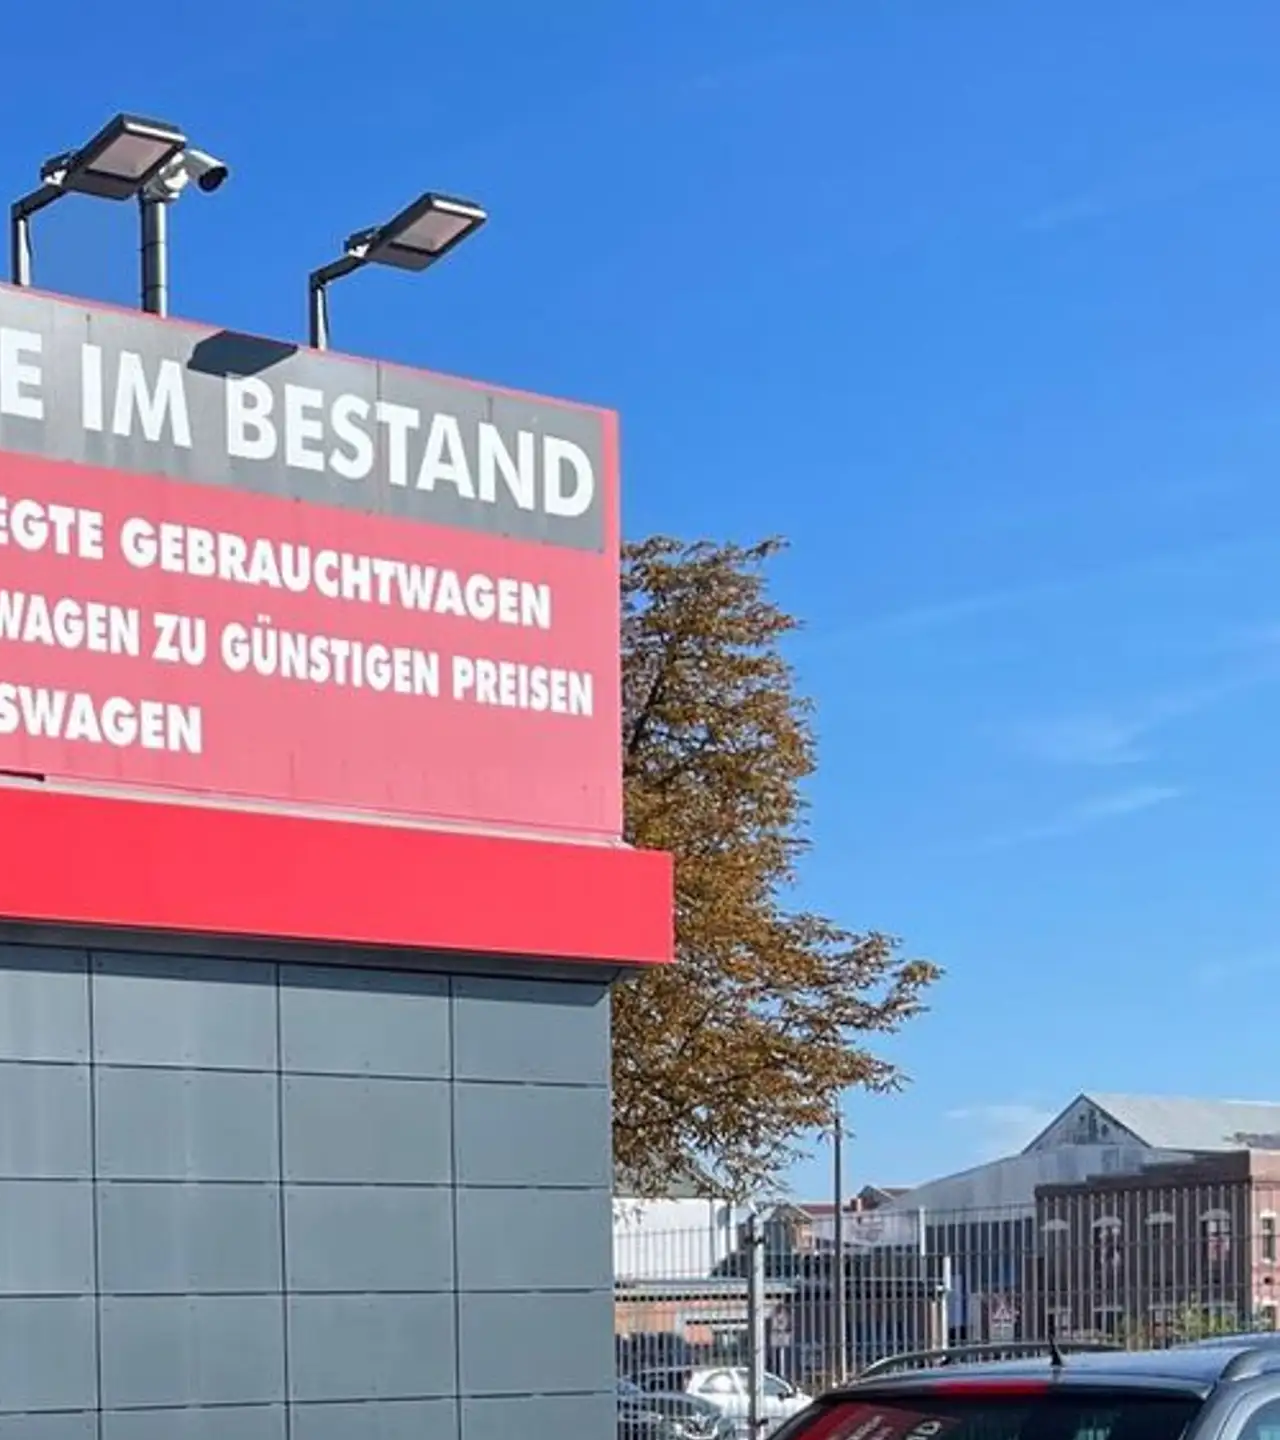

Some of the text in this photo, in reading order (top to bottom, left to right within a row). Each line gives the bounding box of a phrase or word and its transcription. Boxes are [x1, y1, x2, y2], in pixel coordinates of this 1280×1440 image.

[81, 344, 193, 449] IM
[225, 373, 596, 518] BESTAND
[120, 517, 551, 629] GEBRAUCHTWAGEN
[153, 613, 207, 665] ZU
[221, 615, 439, 698] GÜNSTIGEN
[452, 656, 593, 717] PREISEN
